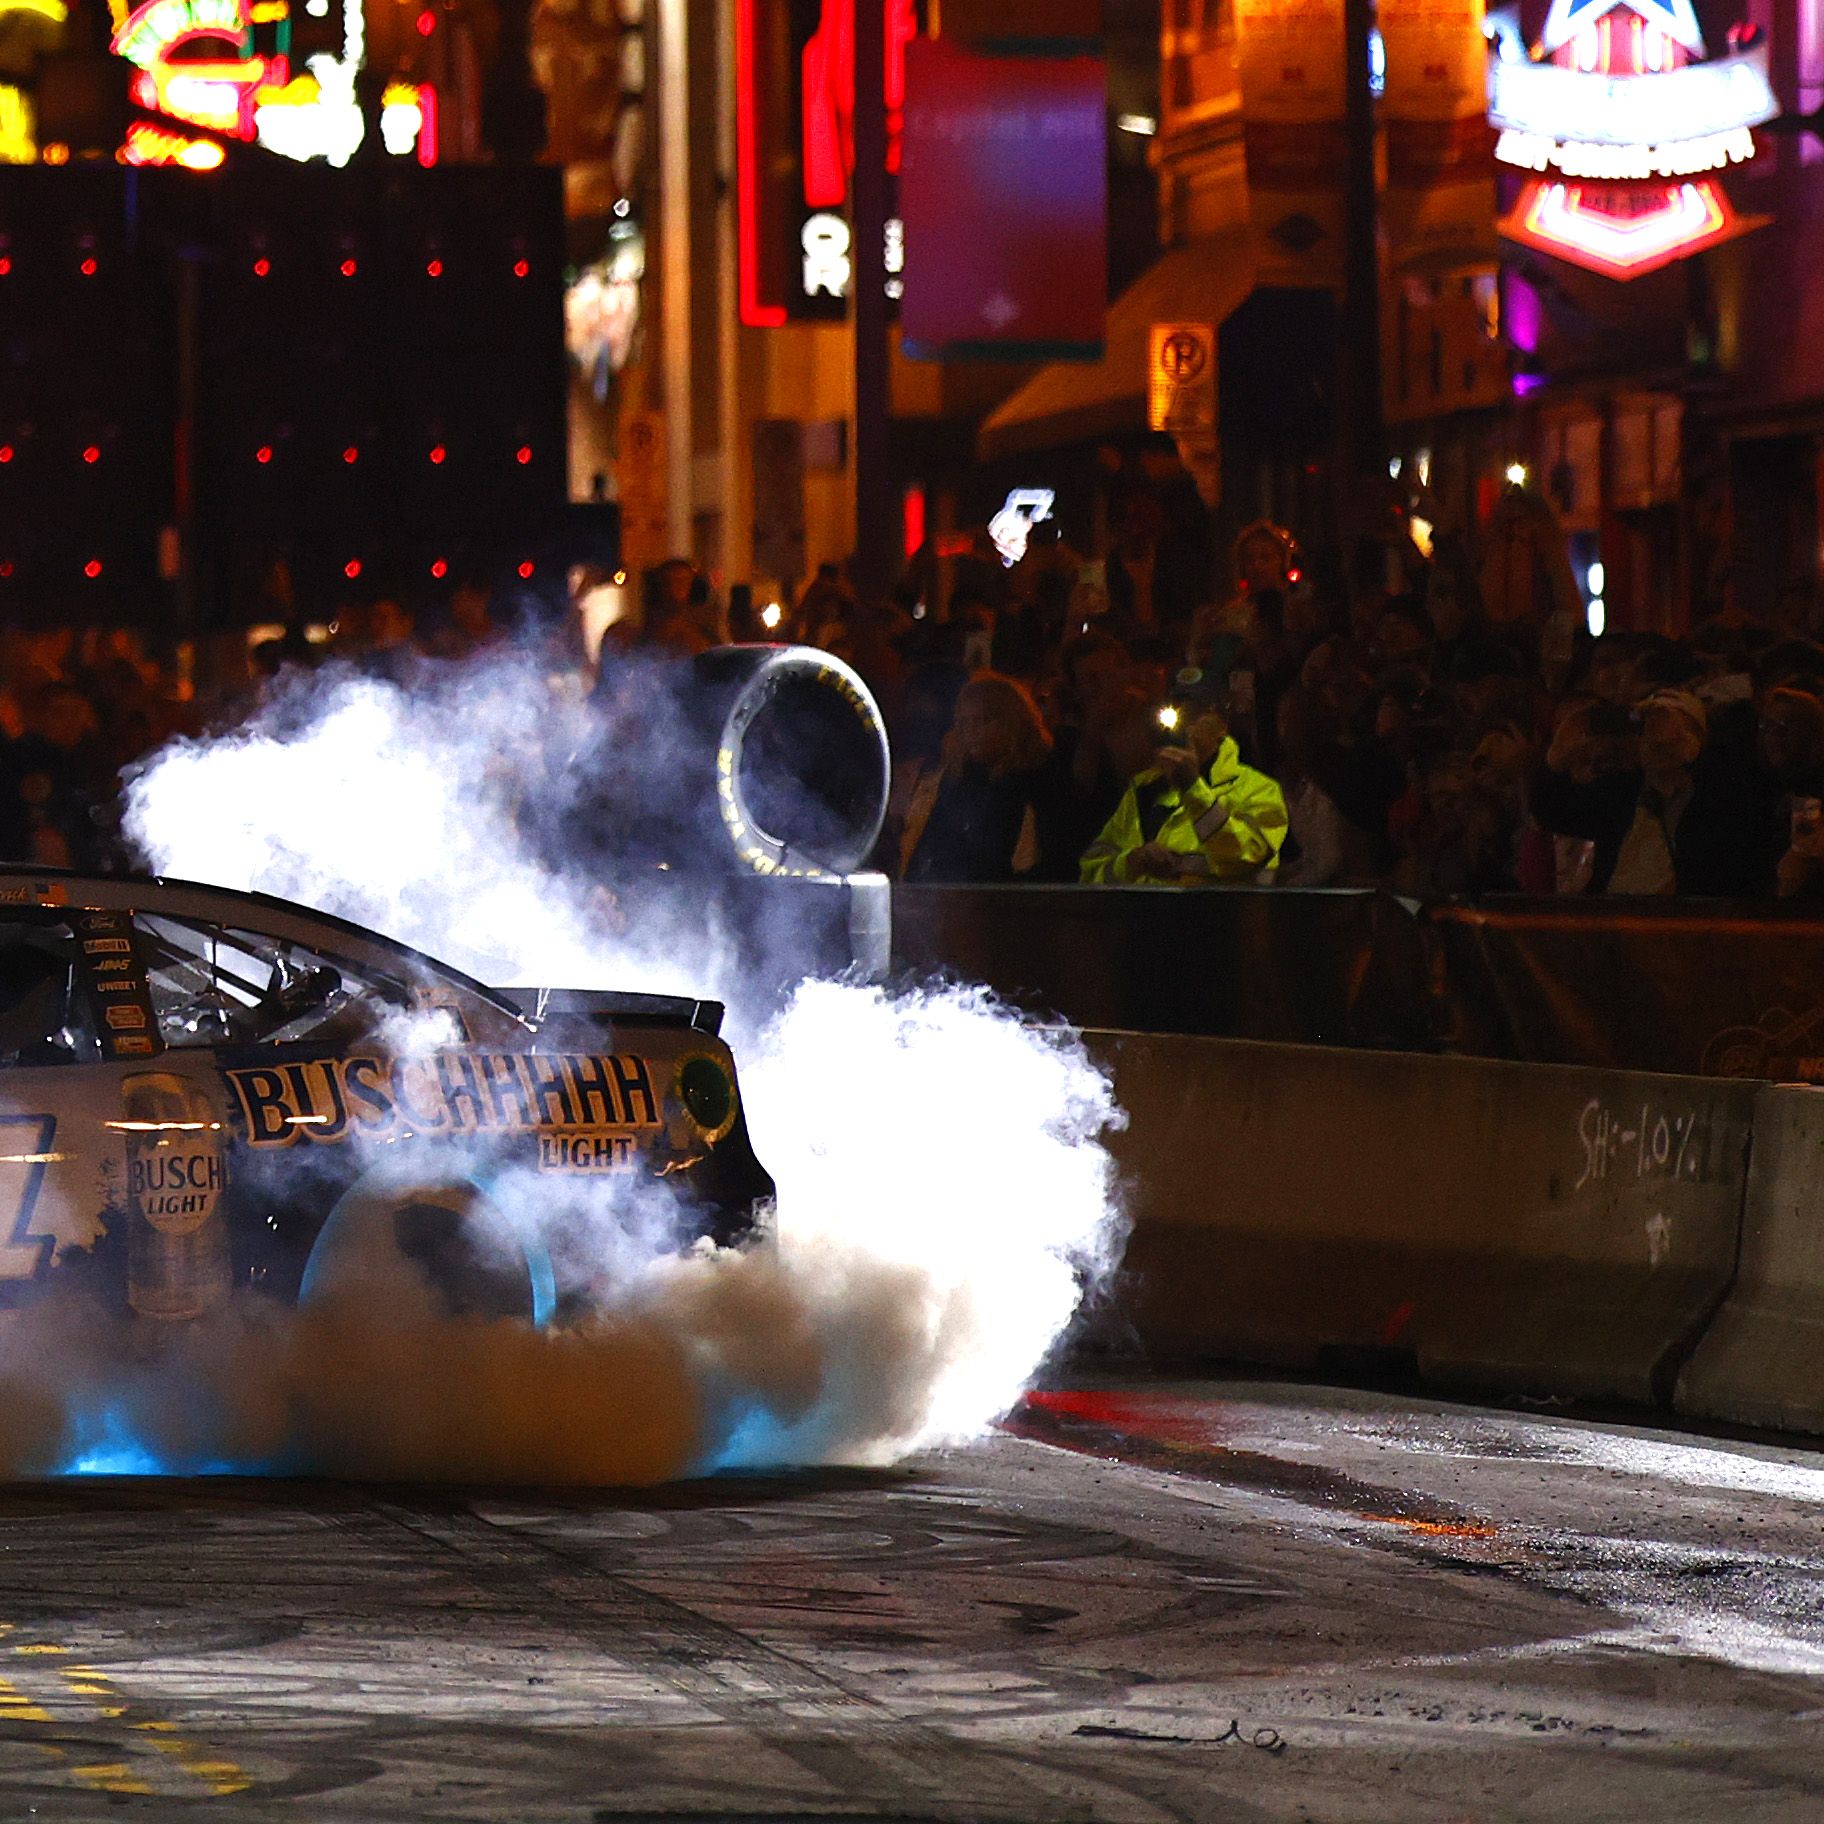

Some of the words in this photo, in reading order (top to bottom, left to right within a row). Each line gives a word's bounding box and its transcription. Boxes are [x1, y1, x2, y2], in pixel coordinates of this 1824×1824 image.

[540, 1137, 633, 1168] LIGHT
[131, 1155, 230, 1194] BUSCH
[146, 1194, 208, 1216] LIGHT
